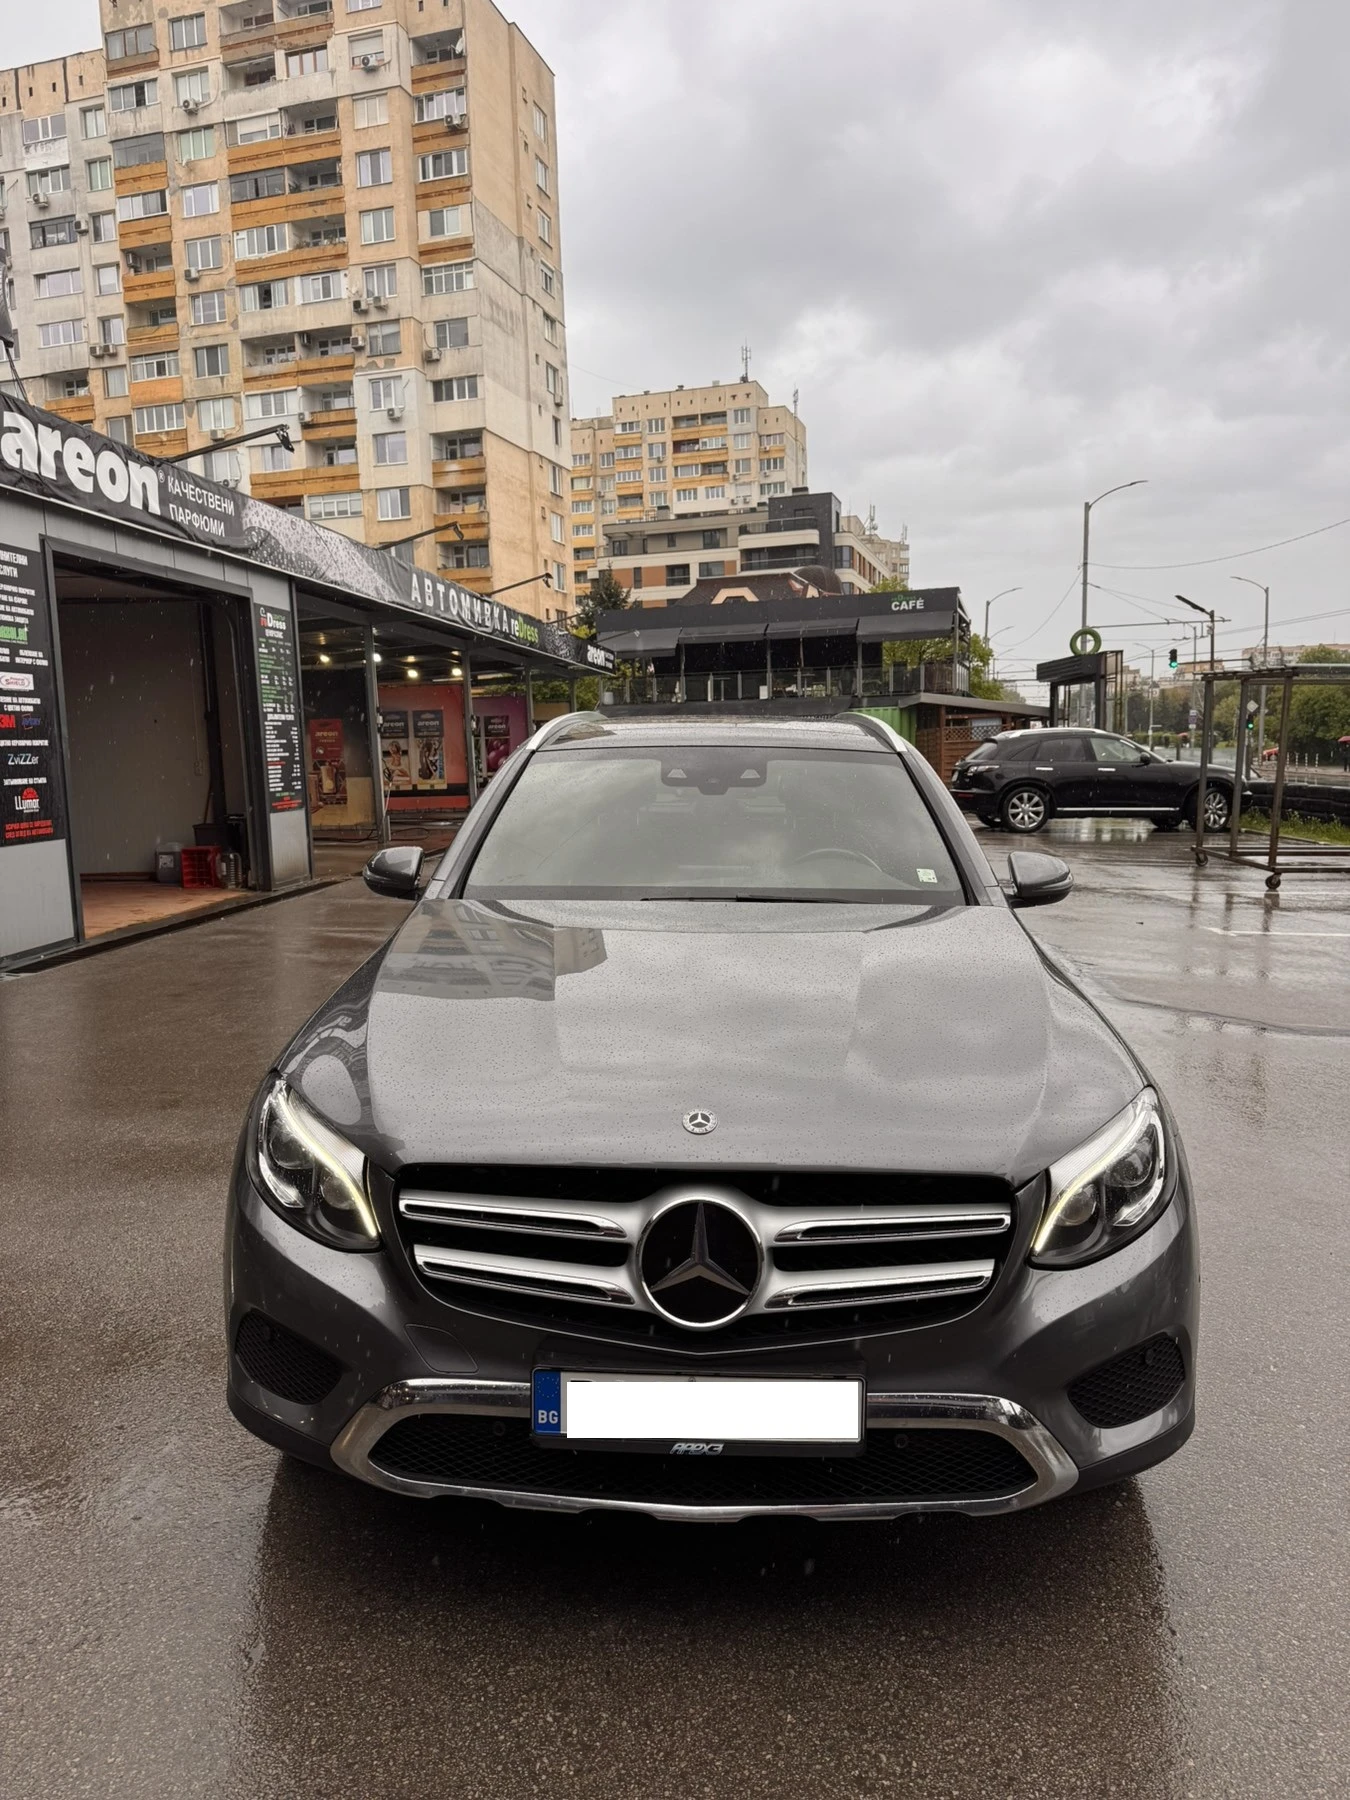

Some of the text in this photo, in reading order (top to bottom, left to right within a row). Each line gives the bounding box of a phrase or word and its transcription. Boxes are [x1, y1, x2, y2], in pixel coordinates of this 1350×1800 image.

[1, 411, 161, 516] areon
[168, 475, 235, 517] КАЧЕСТВЕНИ
[169, 503, 225, 537] ПАРФЮМИ
[411, 573, 539, 643] АВТОМИВКА reDress
[891, 597, 924, 611] CAFÉ
[538, 1410, 559, 1424] BG
